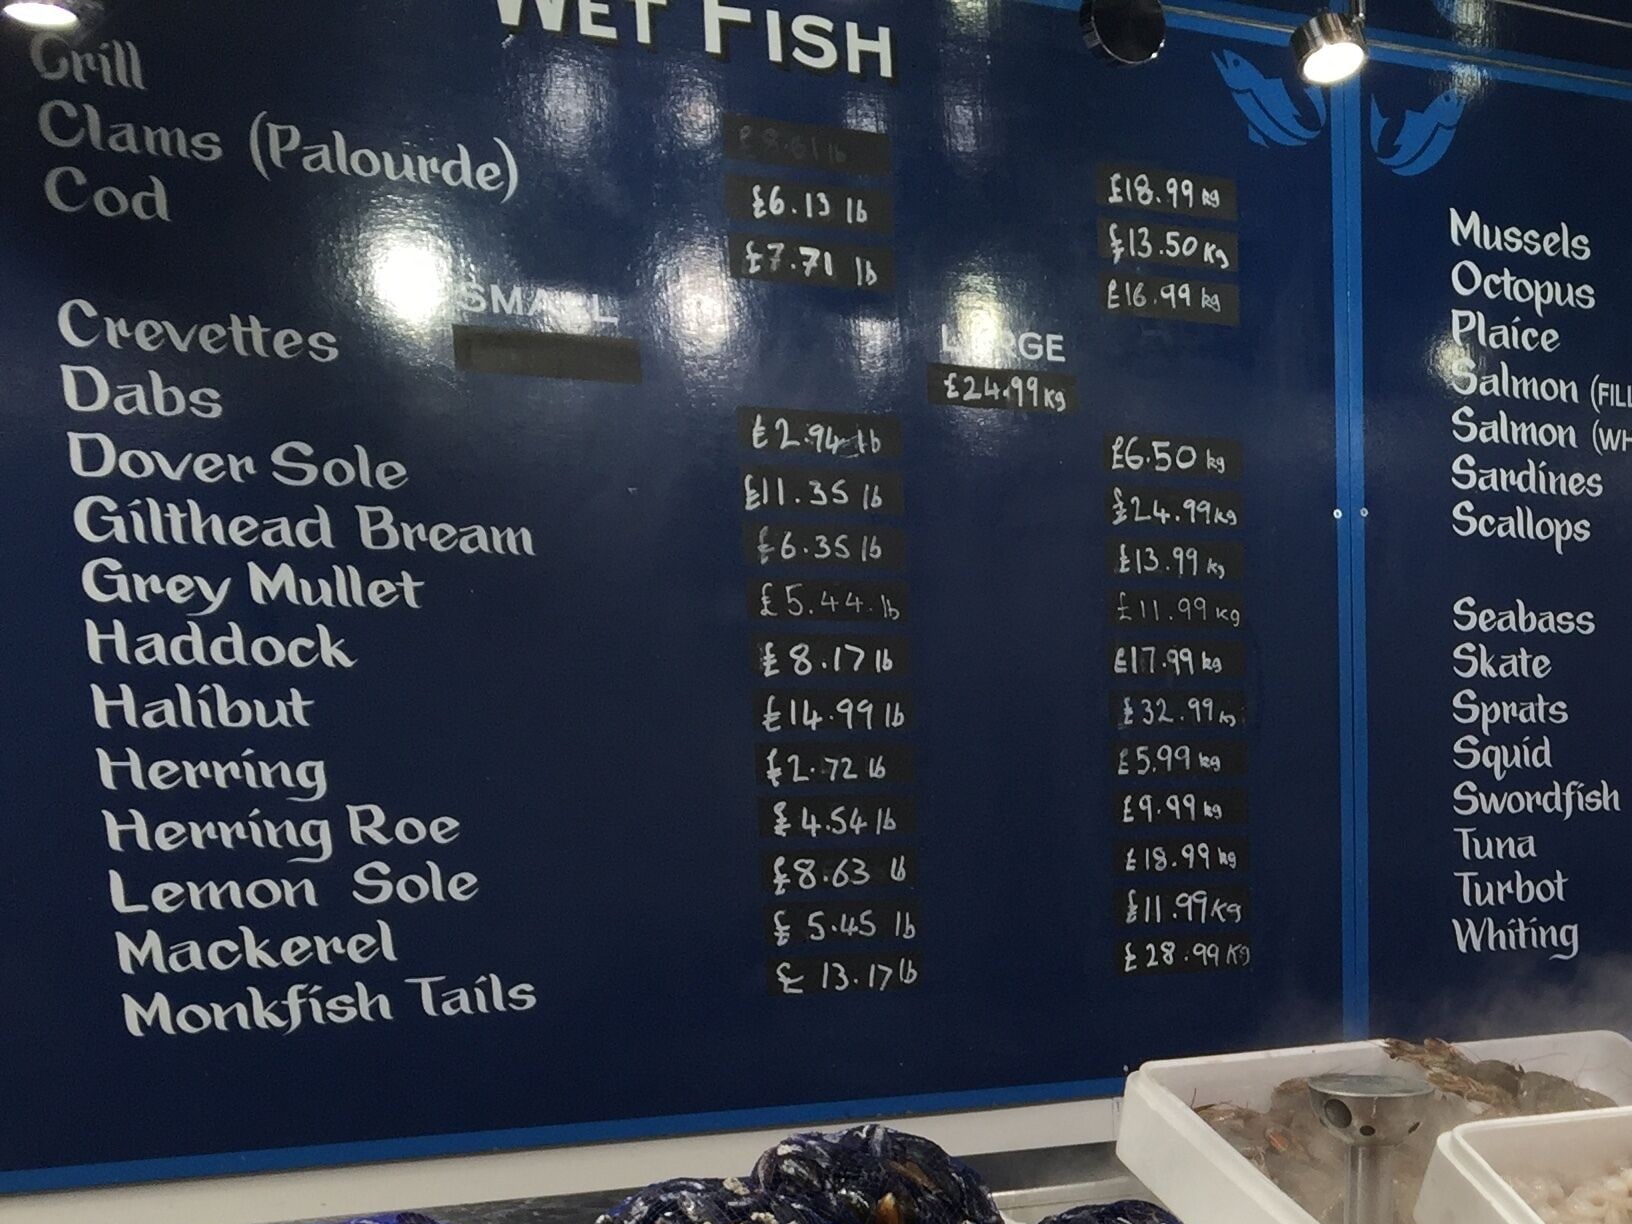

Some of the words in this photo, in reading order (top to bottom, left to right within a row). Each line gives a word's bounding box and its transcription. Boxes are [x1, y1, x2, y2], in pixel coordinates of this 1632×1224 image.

[703, 0, 893, 77] FISH
[38, 100, 223, 162] Clams
[249, 110, 518, 203] (Palourde)
[45, 166, 171, 222] Cod
[1449, 208, 1591, 261] Mussels
[1451, 260, 1596, 317] Octopus
[58, 298, 339, 363] Crevettes
[941, 323, 1066, 362] LRGE
[1451, 308, 1561, 353] Plaice
[61, 365, 223, 418] Dabs
[1451, 358, 1579, 404] Salmon
[1451, 406, 1578, 449] Salmon
[67, 431, 257, 484] Dover
[271, 440, 408, 490] Sole
[1451, 453, 1604, 497] Sardines
[73, 495, 335, 549] Gilthead
[355, 504, 536, 556] Bream
[1452, 500, 1591, 555] Scallops
[81, 557, 232, 617] Grey
[247, 561, 426, 610] Mullet
[1452, 596, 1596, 635] Seabass
[84, 618, 358, 668] Haddock
[1452, 642, 1552, 679] Skate
[90, 683, 315, 729] Halibut
[1452, 689, 1569, 736] Sprats
[95, 747, 327, 802] Herring
[1452, 735, 1552, 781] Squid
[1452, 780, 1621, 821] Swordfish
[101, 808, 333, 863] Herring
[345, 803, 461, 847] Roe
[1453, 827, 1537, 860] Tuna
[108, 868, 319, 914] Lemon
[352, 860, 480, 905] Sole
[1454, 870, 1569, 907] Turbot
[115, 920, 399, 975] Mackerel
[1451, 917, 1579, 961] Whiting
[121, 981, 394, 1037] Monkfish
[405, 973, 537, 1017] Tails
